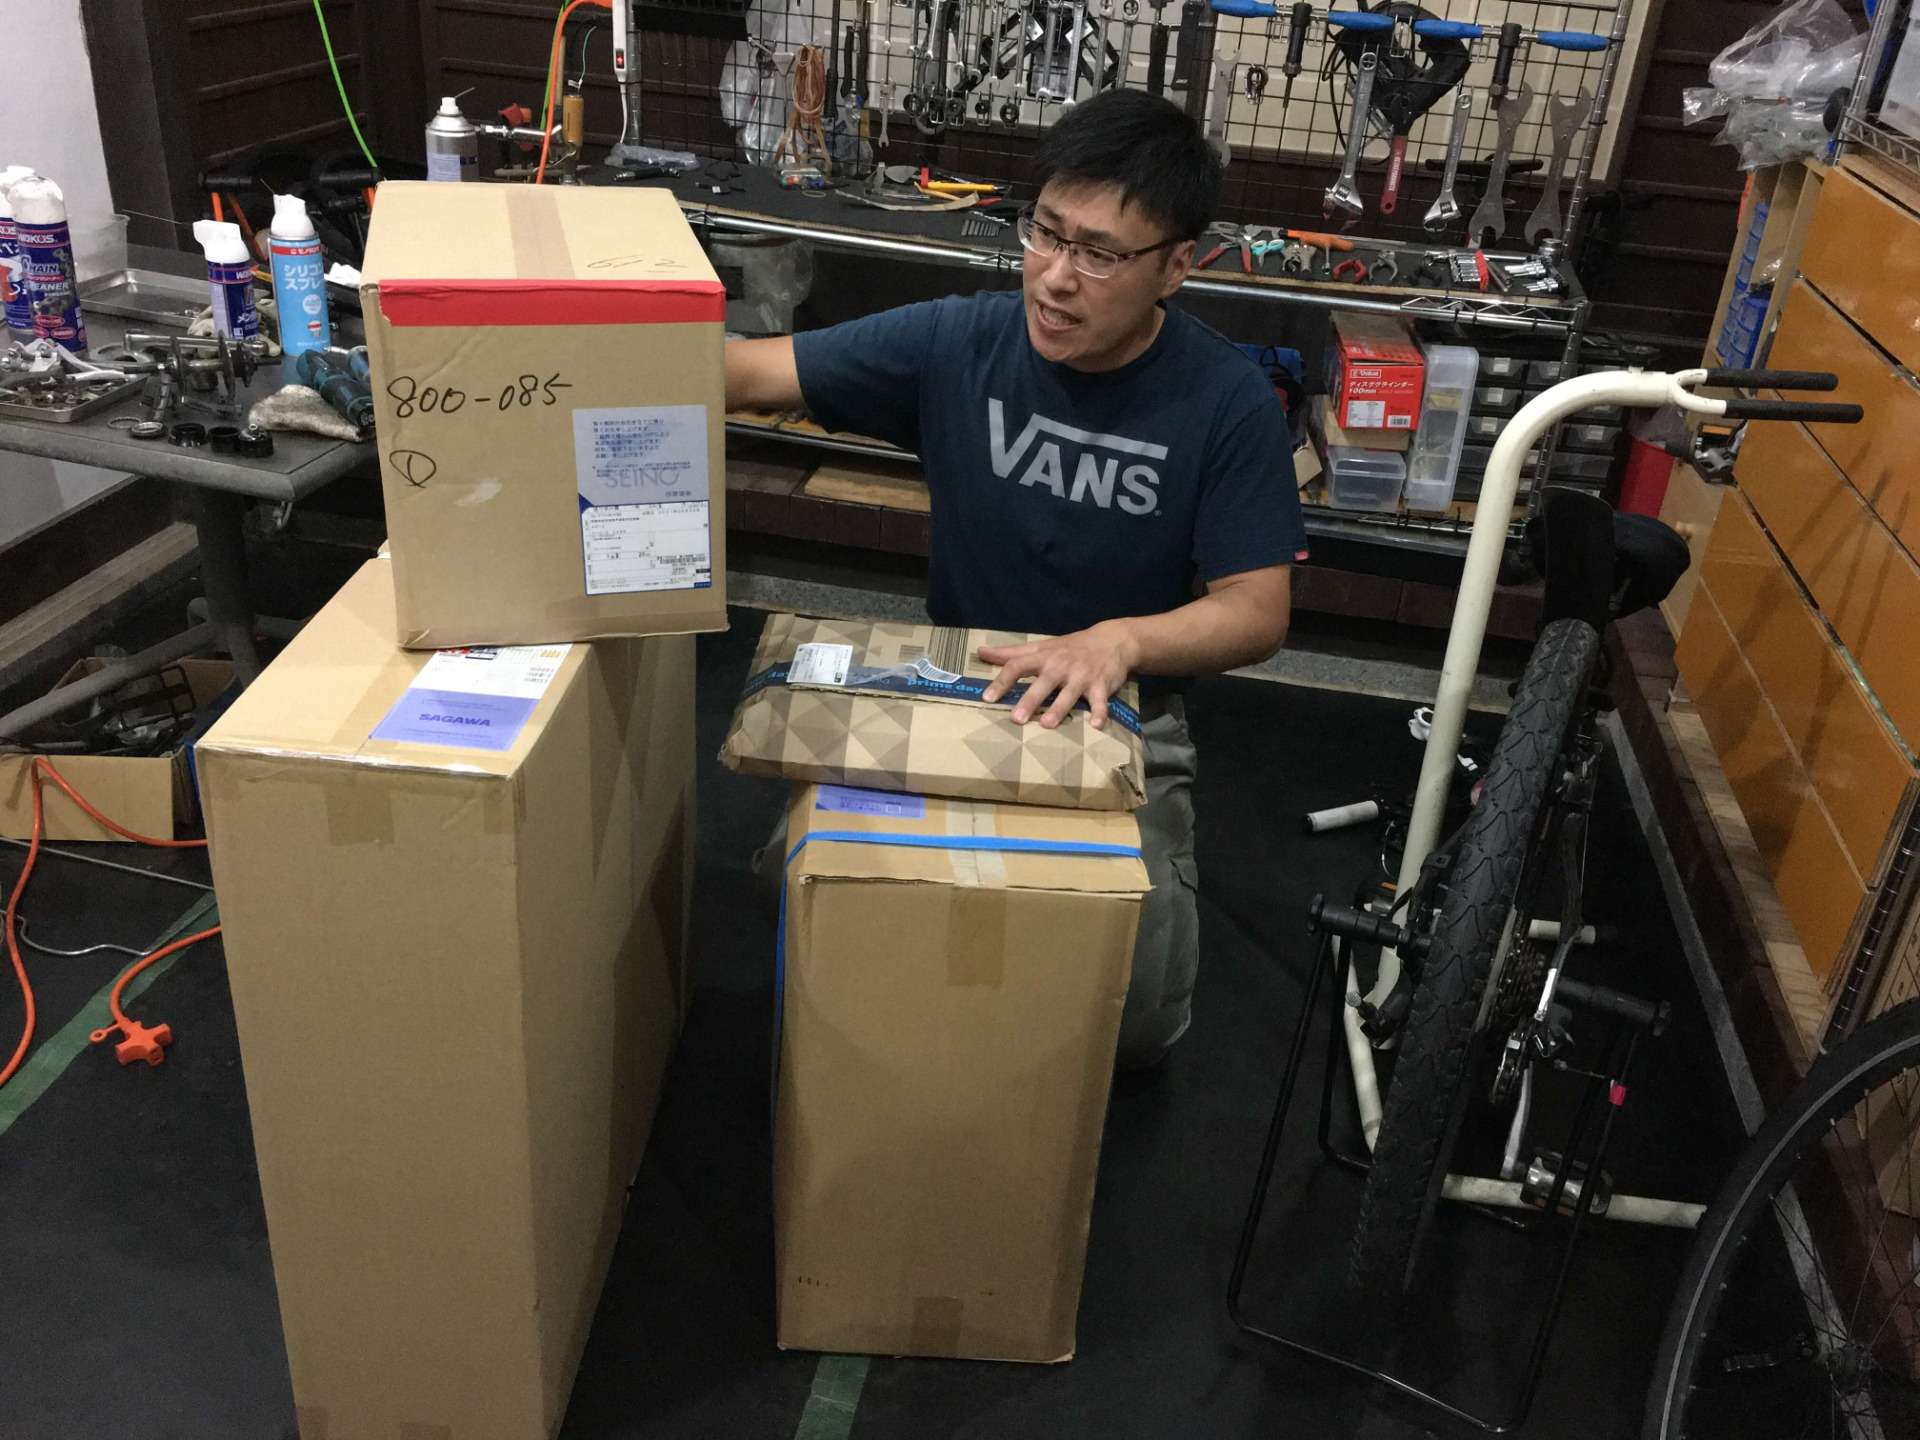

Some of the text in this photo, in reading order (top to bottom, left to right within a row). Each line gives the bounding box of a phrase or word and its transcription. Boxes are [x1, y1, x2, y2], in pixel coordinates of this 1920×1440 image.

[284, 277, 322, 291] スプレ
[387, 373, 573, 418] 800-085
[988, 397, 1169, 516] VANS
[605, 466, 680, 488] SEINO
[907, 677, 953, 689] prime
[955, 682, 983, 695] day
[418, 713, 491, 727] SAGAWA
